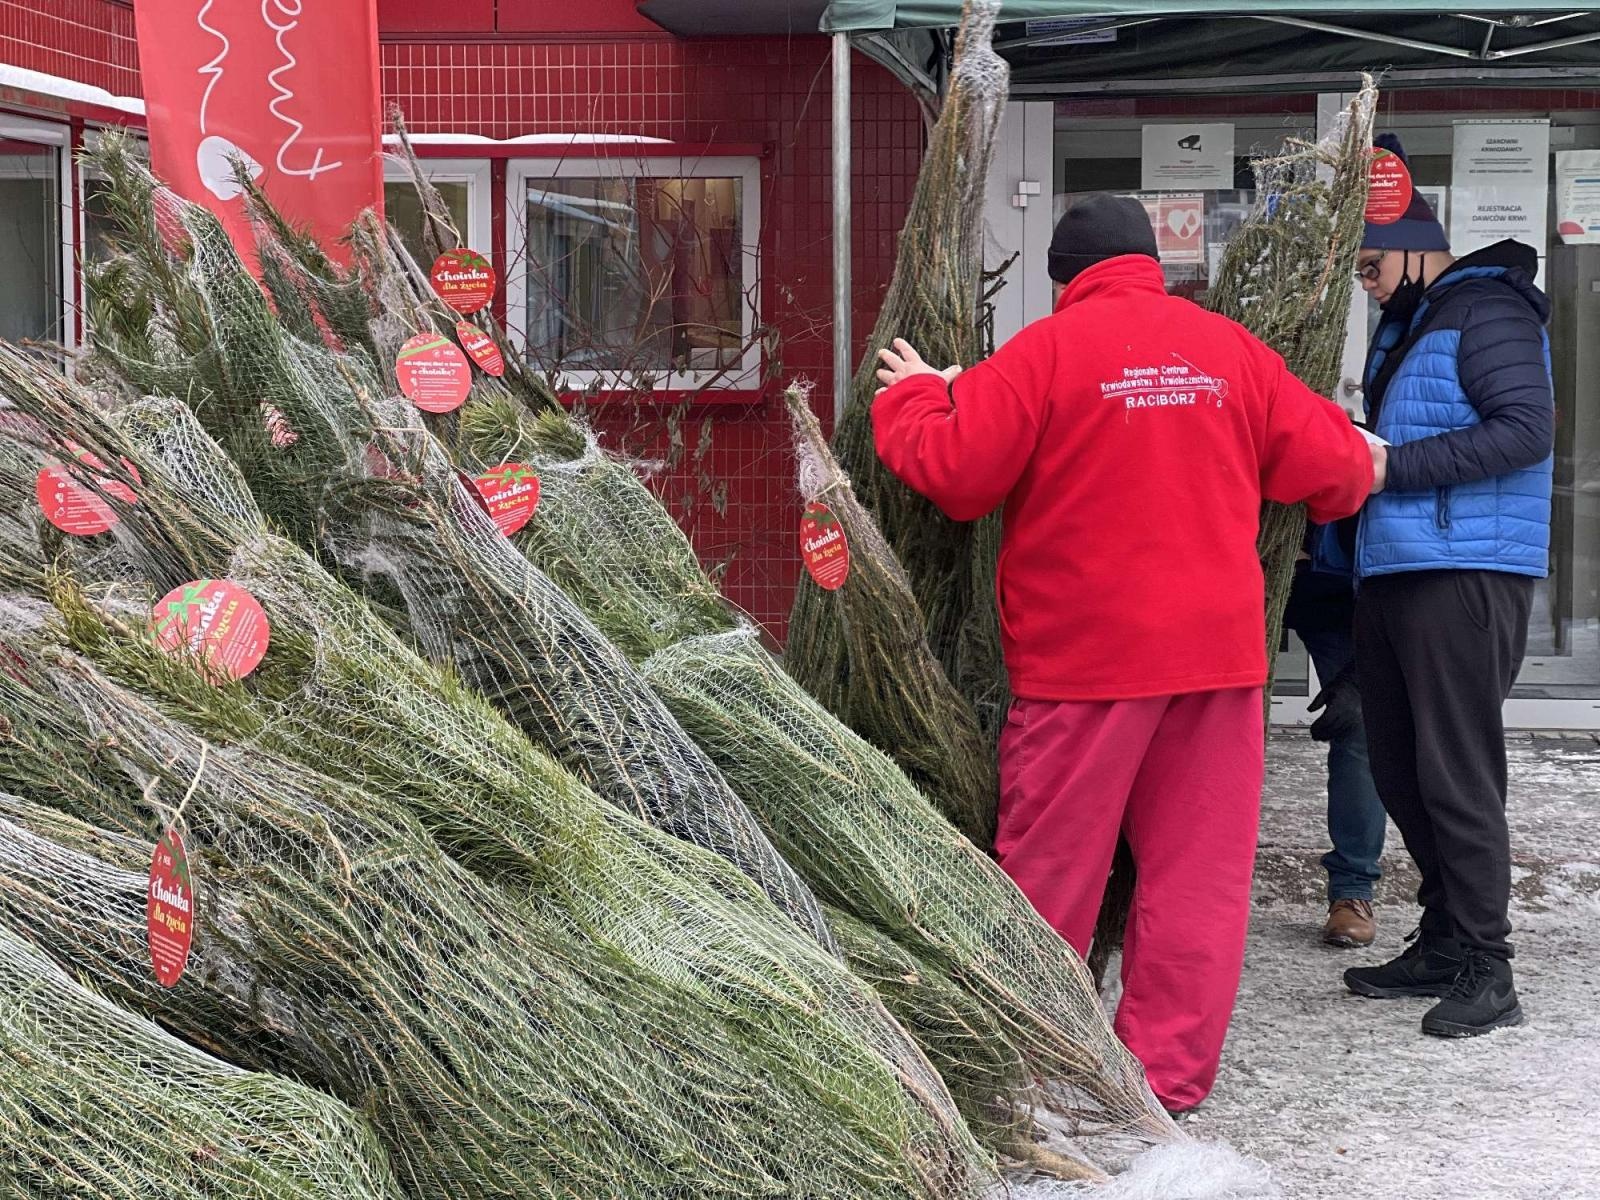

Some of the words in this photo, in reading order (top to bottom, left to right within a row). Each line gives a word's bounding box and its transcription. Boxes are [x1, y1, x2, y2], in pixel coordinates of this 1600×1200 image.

[1472, 213, 1507, 222] DAWCÓW
[1508, 214, 1527, 222] KRWI
[436, 268, 489, 282] Choinka
[442, 281, 458, 290] dla
[460, 280, 487, 291] życia
[1123, 366, 1159, 379] Regionalne
[1161, 365, 1189, 375] Centrum
[1100, 378, 1153, 393] Krwiodawstwa
[1126, 391, 1196, 409] RACIBÓRZ
[804, 528, 841, 553] Choinka
[823, 543, 843, 558] życia
[151, 873, 189, 913] Choinka
[166, 911, 187, 935] życia
